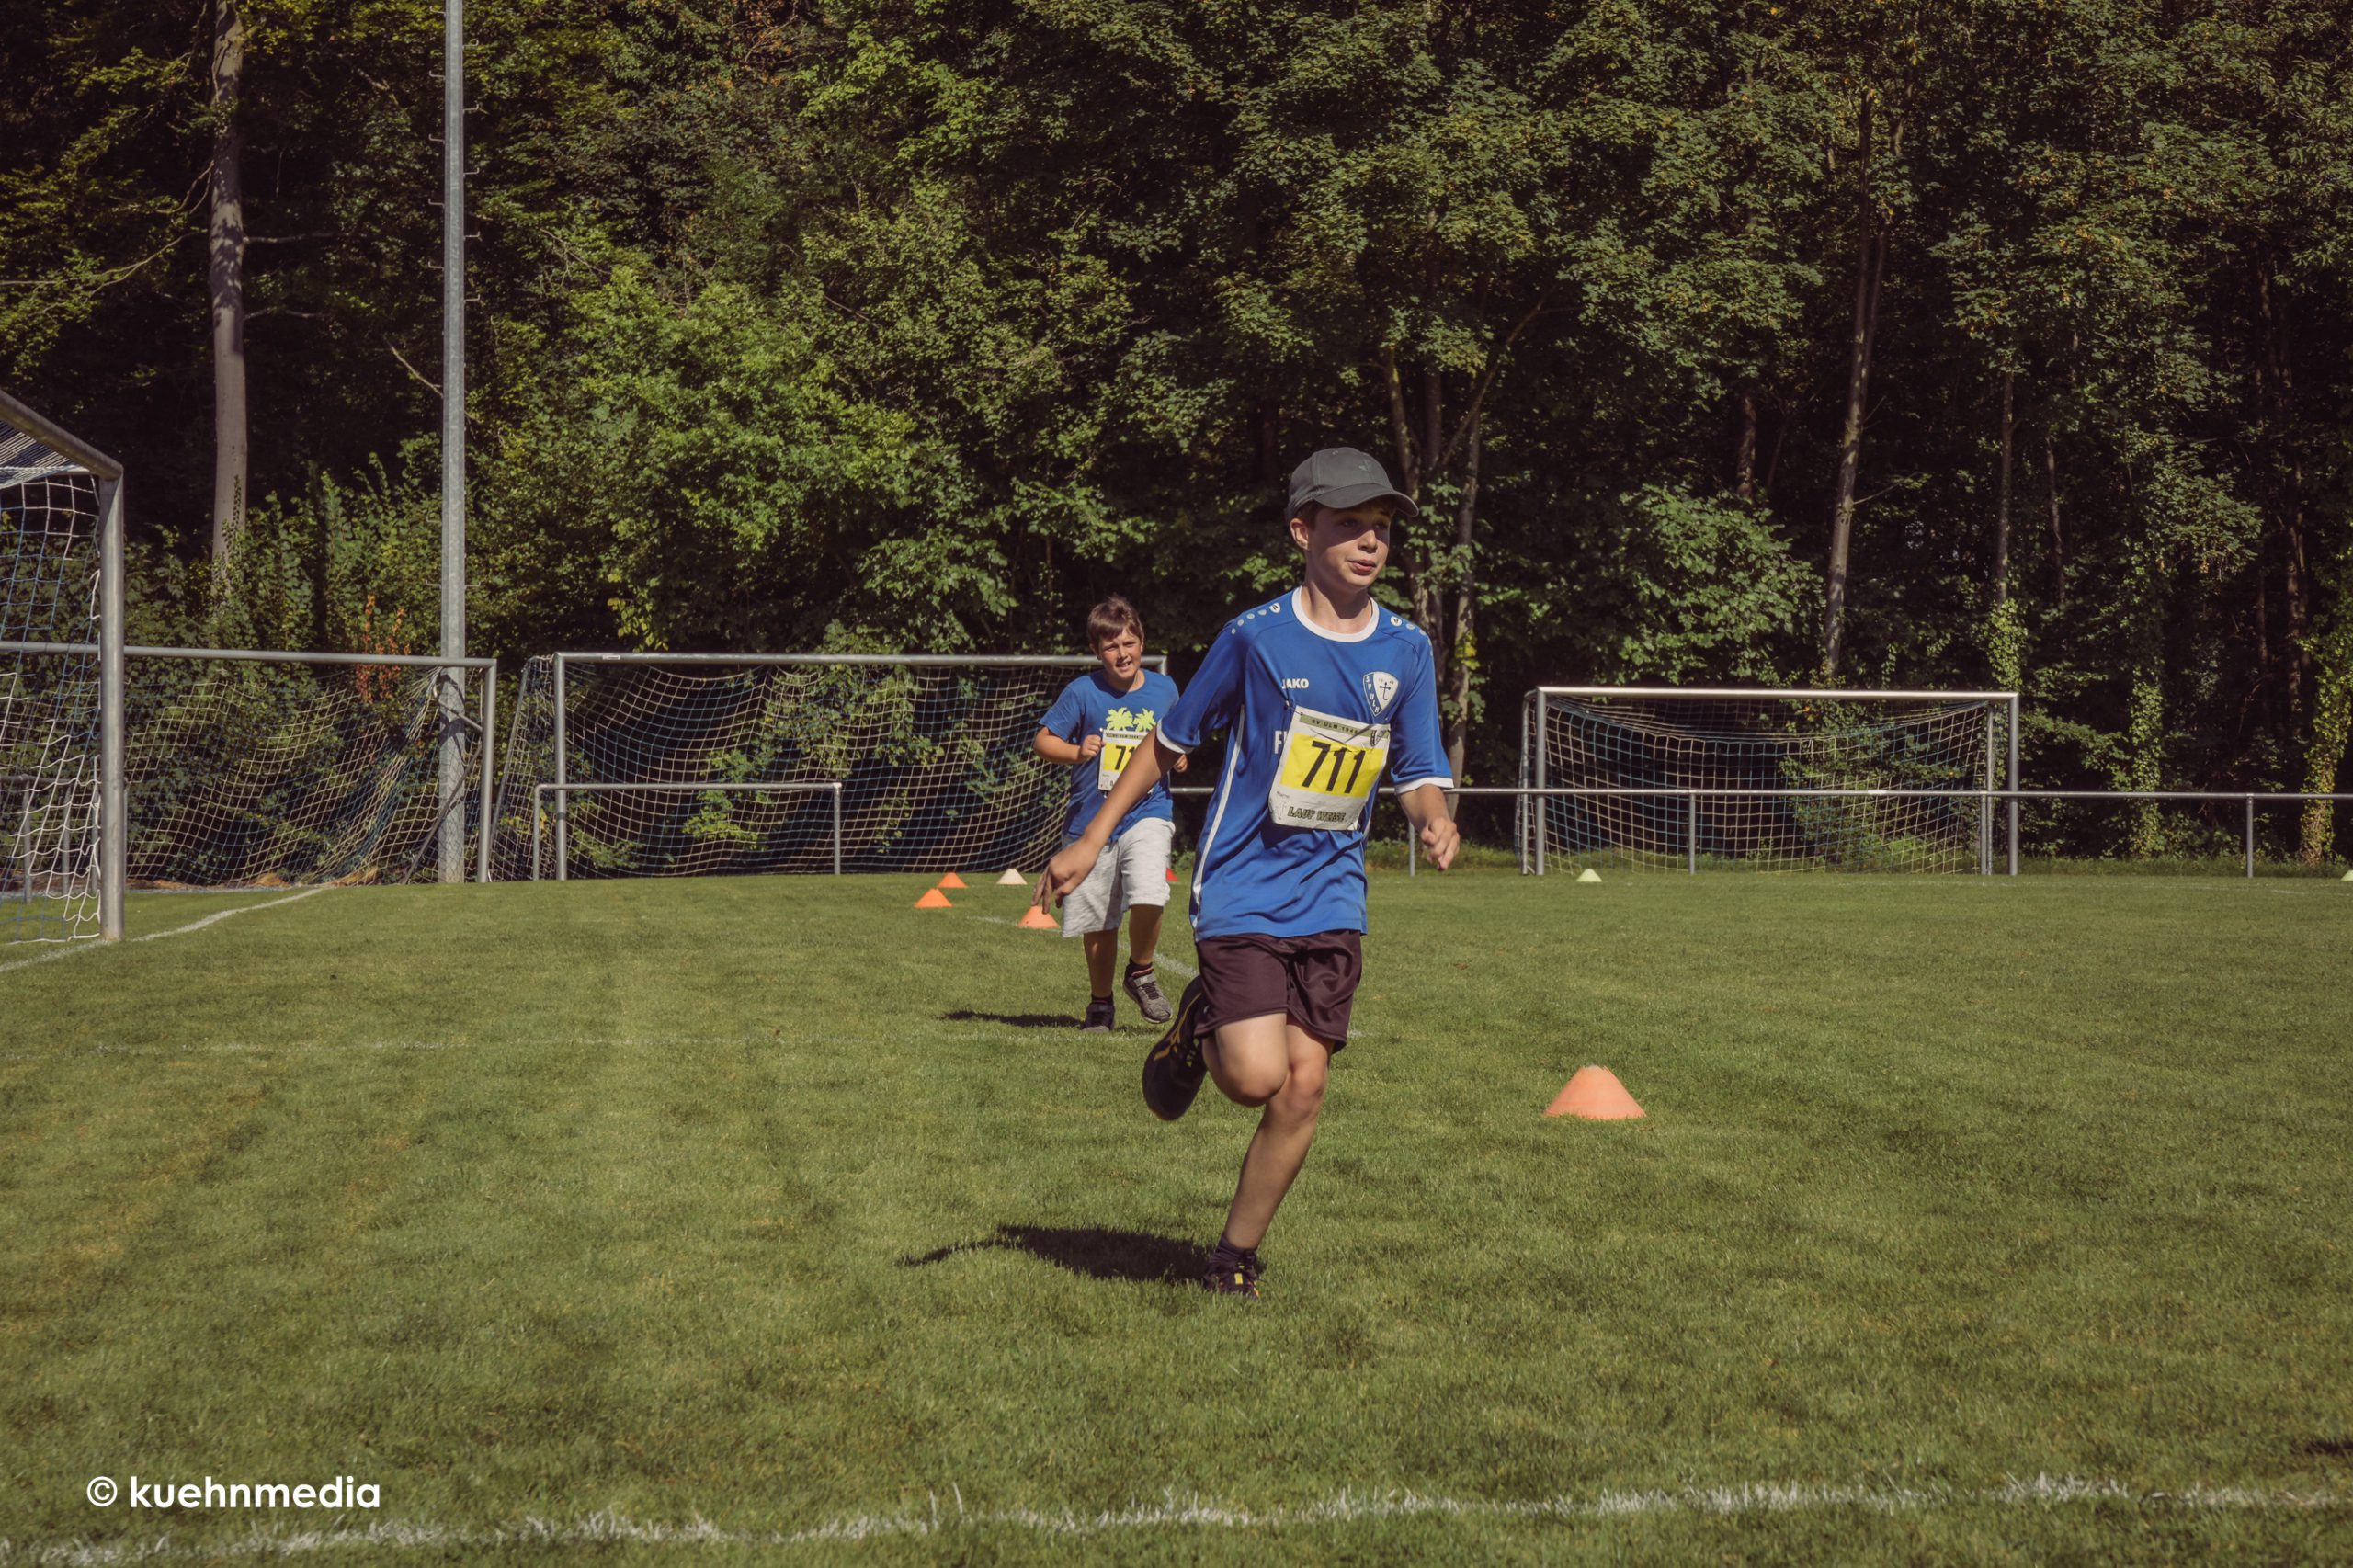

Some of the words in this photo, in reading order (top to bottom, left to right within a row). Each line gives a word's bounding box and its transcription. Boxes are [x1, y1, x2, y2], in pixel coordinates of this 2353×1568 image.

[1281, 678, 1310, 689] JAKO
[1324, 722, 1338, 730] ULM
[1302, 740, 1366, 794] 711
[1288, 806, 1316, 820] LAUF
